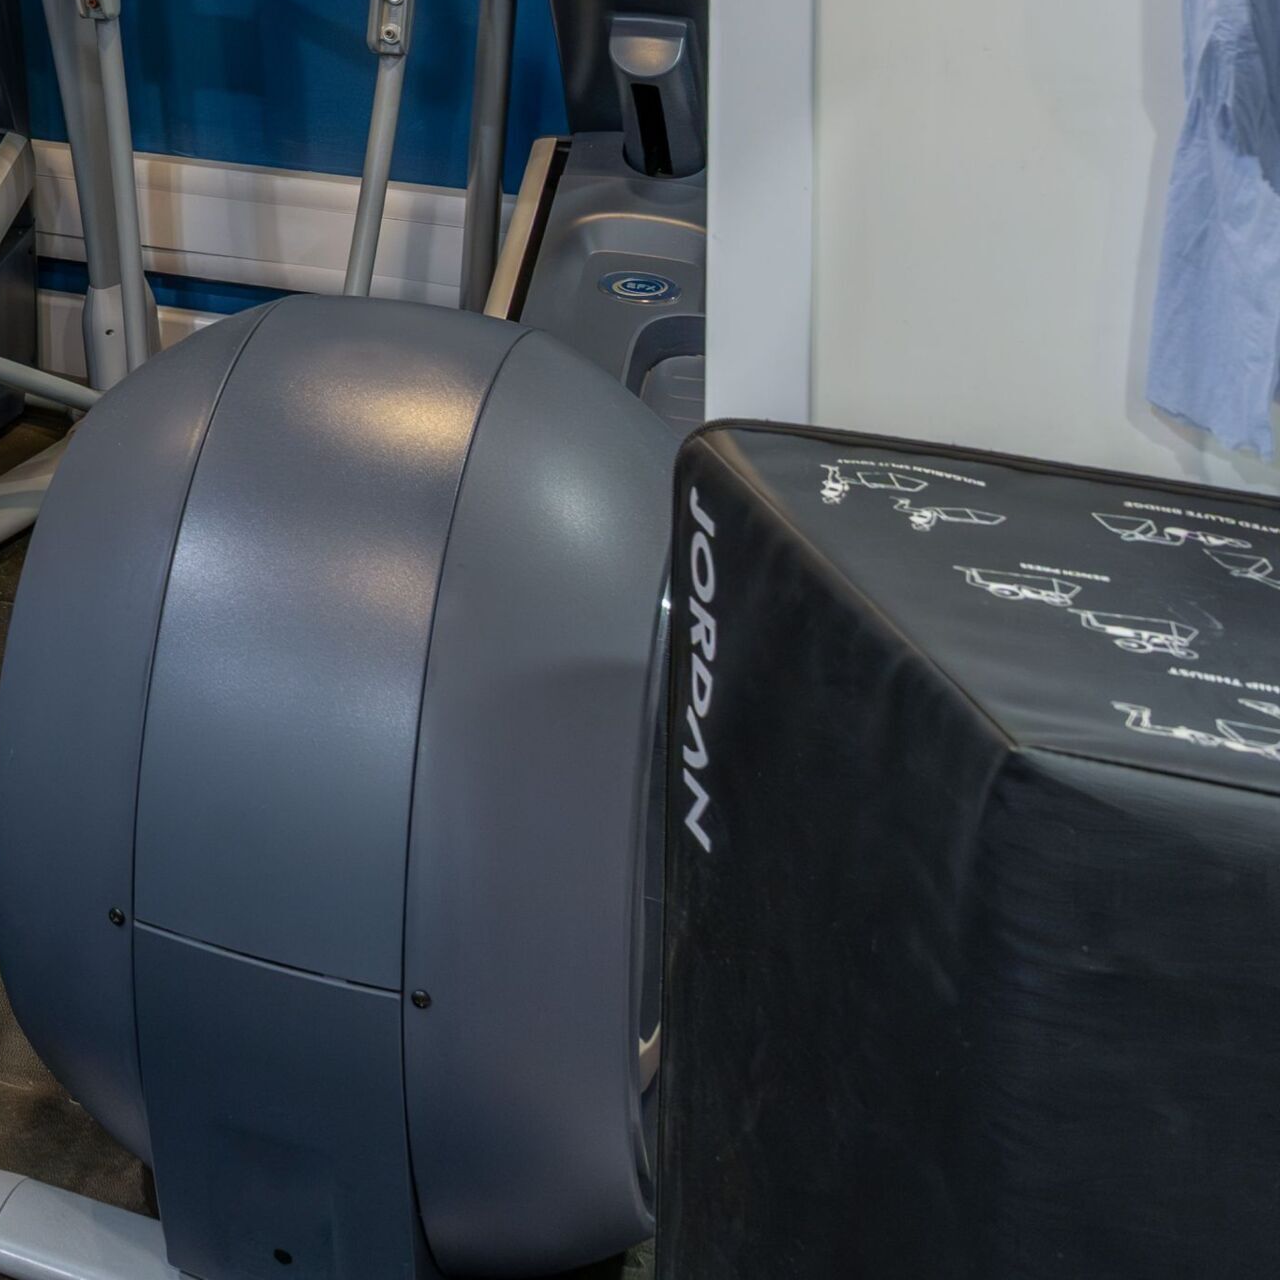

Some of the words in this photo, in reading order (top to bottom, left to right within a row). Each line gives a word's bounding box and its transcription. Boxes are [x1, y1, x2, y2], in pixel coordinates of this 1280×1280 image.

[913, 466, 986, 487] BULGARIAN
[1123, 501, 1183, 516] BRIDGE
[1185, 510, 1237, 525] GLUTE
[1238, 521, 1280, 534] ATED
[682, 486, 716, 853] JORDAN
[1168, 667, 1243, 688] THRUST
